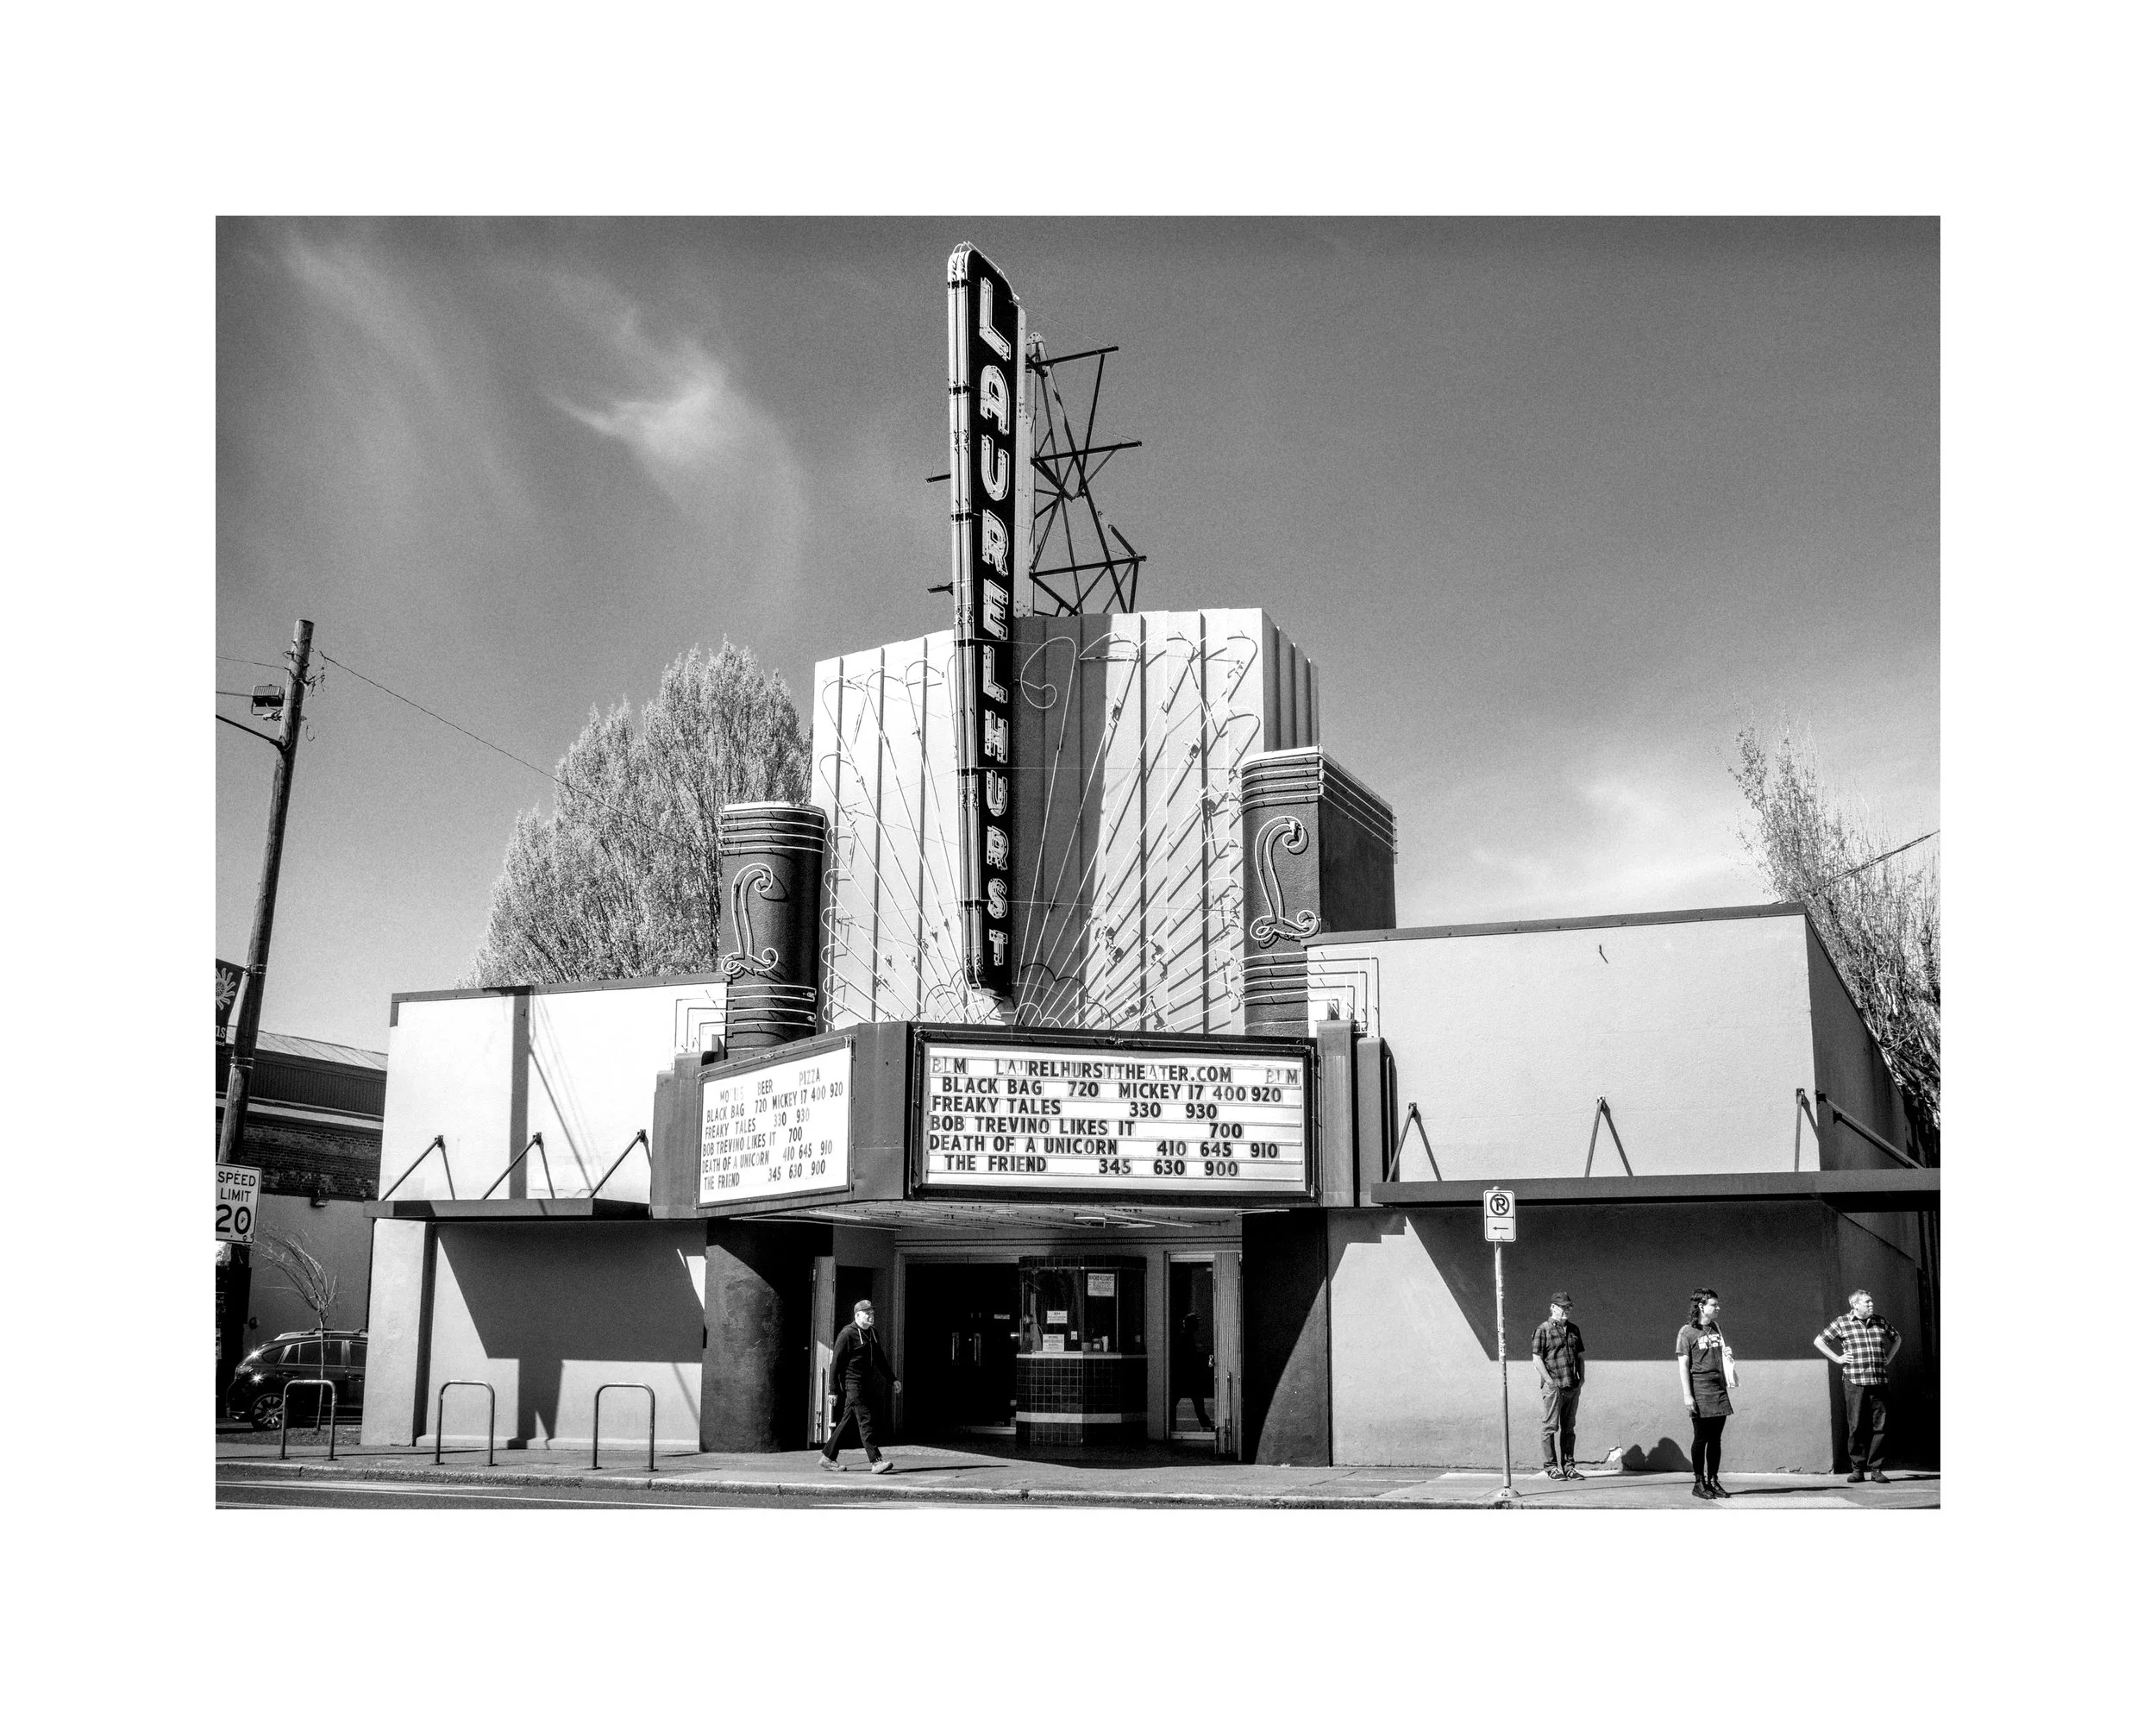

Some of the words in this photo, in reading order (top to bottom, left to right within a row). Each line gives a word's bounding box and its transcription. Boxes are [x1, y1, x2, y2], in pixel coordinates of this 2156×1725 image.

[979, 276, 1012, 967] LAURELHURST
[757, 1079, 774, 1096] BEER
[799, 1067, 820, 1087] PIZZA
[994, 1058, 1232, 1082] LAURELHURSTTHEATER.COM
[707, 1106, 728, 1124] BLACK
[730, 1102, 745, 1120] BAG
[755, 1097, 768, 1114] 720
[772, 1091, 798, 1111] MICKEY
[811, 1087, 826, 1102] 400
[830, 1081, 843, 1098] 920
[942, 1076, 999, 1094] BLACK
[1007, 1080, 1042, 1095] BAG
[1068, 1081, 1099, 1097] 720
[1119, 1082, 1181, 1100] MICKEY
[1188, 1084, 1204, 1100] 17
[1213, 1085, 1246, 1101] 400
[1251, 1086, 1282, 1102] 920
[931, 1095, 999, 1113] FREAKY
[1006, 1098, 1061, 1115] TALES
[1129, 1101, 1161, 1118] 330
[1186, 1103, 1218, 1120] 930
[705, 1122, 730, 1140] FREAKY
[735, 1117, 756, 1136] TALES
[774, 1111, 787, 1128] 330
[796, 1107, 811, 1124] 930
[931, 1115, 964, 1132] BOB
[975, 1117, 1050, 1134] TREVINO
[1060, 1119, 1108, 1135] LIKES
[1119, 1120, 1135, 1136] IT
[1209, 1123, 1243, 1138] 700
[703, 1141, 715, 1157] BOB
[716, 1136, 745, 1155] TREVINO
[747, 1132, 766, 1151] LIKES
[769, 1131, 776, 1146] IT
[788, 1126, 803, 1144] 700
[929, 1135, 985, 1151] DEATH
[993, 1136, 1015, 1152] OF
[1025, 1137, 1036, 1152] A
[1044, 1138, 1117, 1155] UNICORN
[1156, 1140, 1187, 1156] 410
[1200, 1141, 1232, 1157] 645
[1250, 1143, 1278, 1157] 910
[702, 1157, 721, 1174] DEATH
[723, 1156, 732, 1171] OF
[732, 1155, 738, 1170] A
[740, 1150, 770, 1169] UNICORN
[782, 1145, 795, 1162] 410
[799, 1142, 812, 1159] 645
[820, 1138, 833, 1157] 910
[945, 1155, 976, 1170] THE
[988, 1156, 1047, 1172] FRIEND
[1099, 1158, 1131, 1175] 345
[1154, 1159, 1185, 1175] 630
[1205, 1161, 1238, 1176] 900
[217, 1170, 256, 1187] SPEED
[704, 1176, 715, 1191] THE
[718, 1171, 740, 1189] FRIEND
[768, 1165, 781, 1182] 345
[788, 1162, 803, 1179] 630
[811, 1158, 826, 1176] 900
[220, 1188, 252, 1203] LIMIT
[216, 1203, 252, 1234] 20
